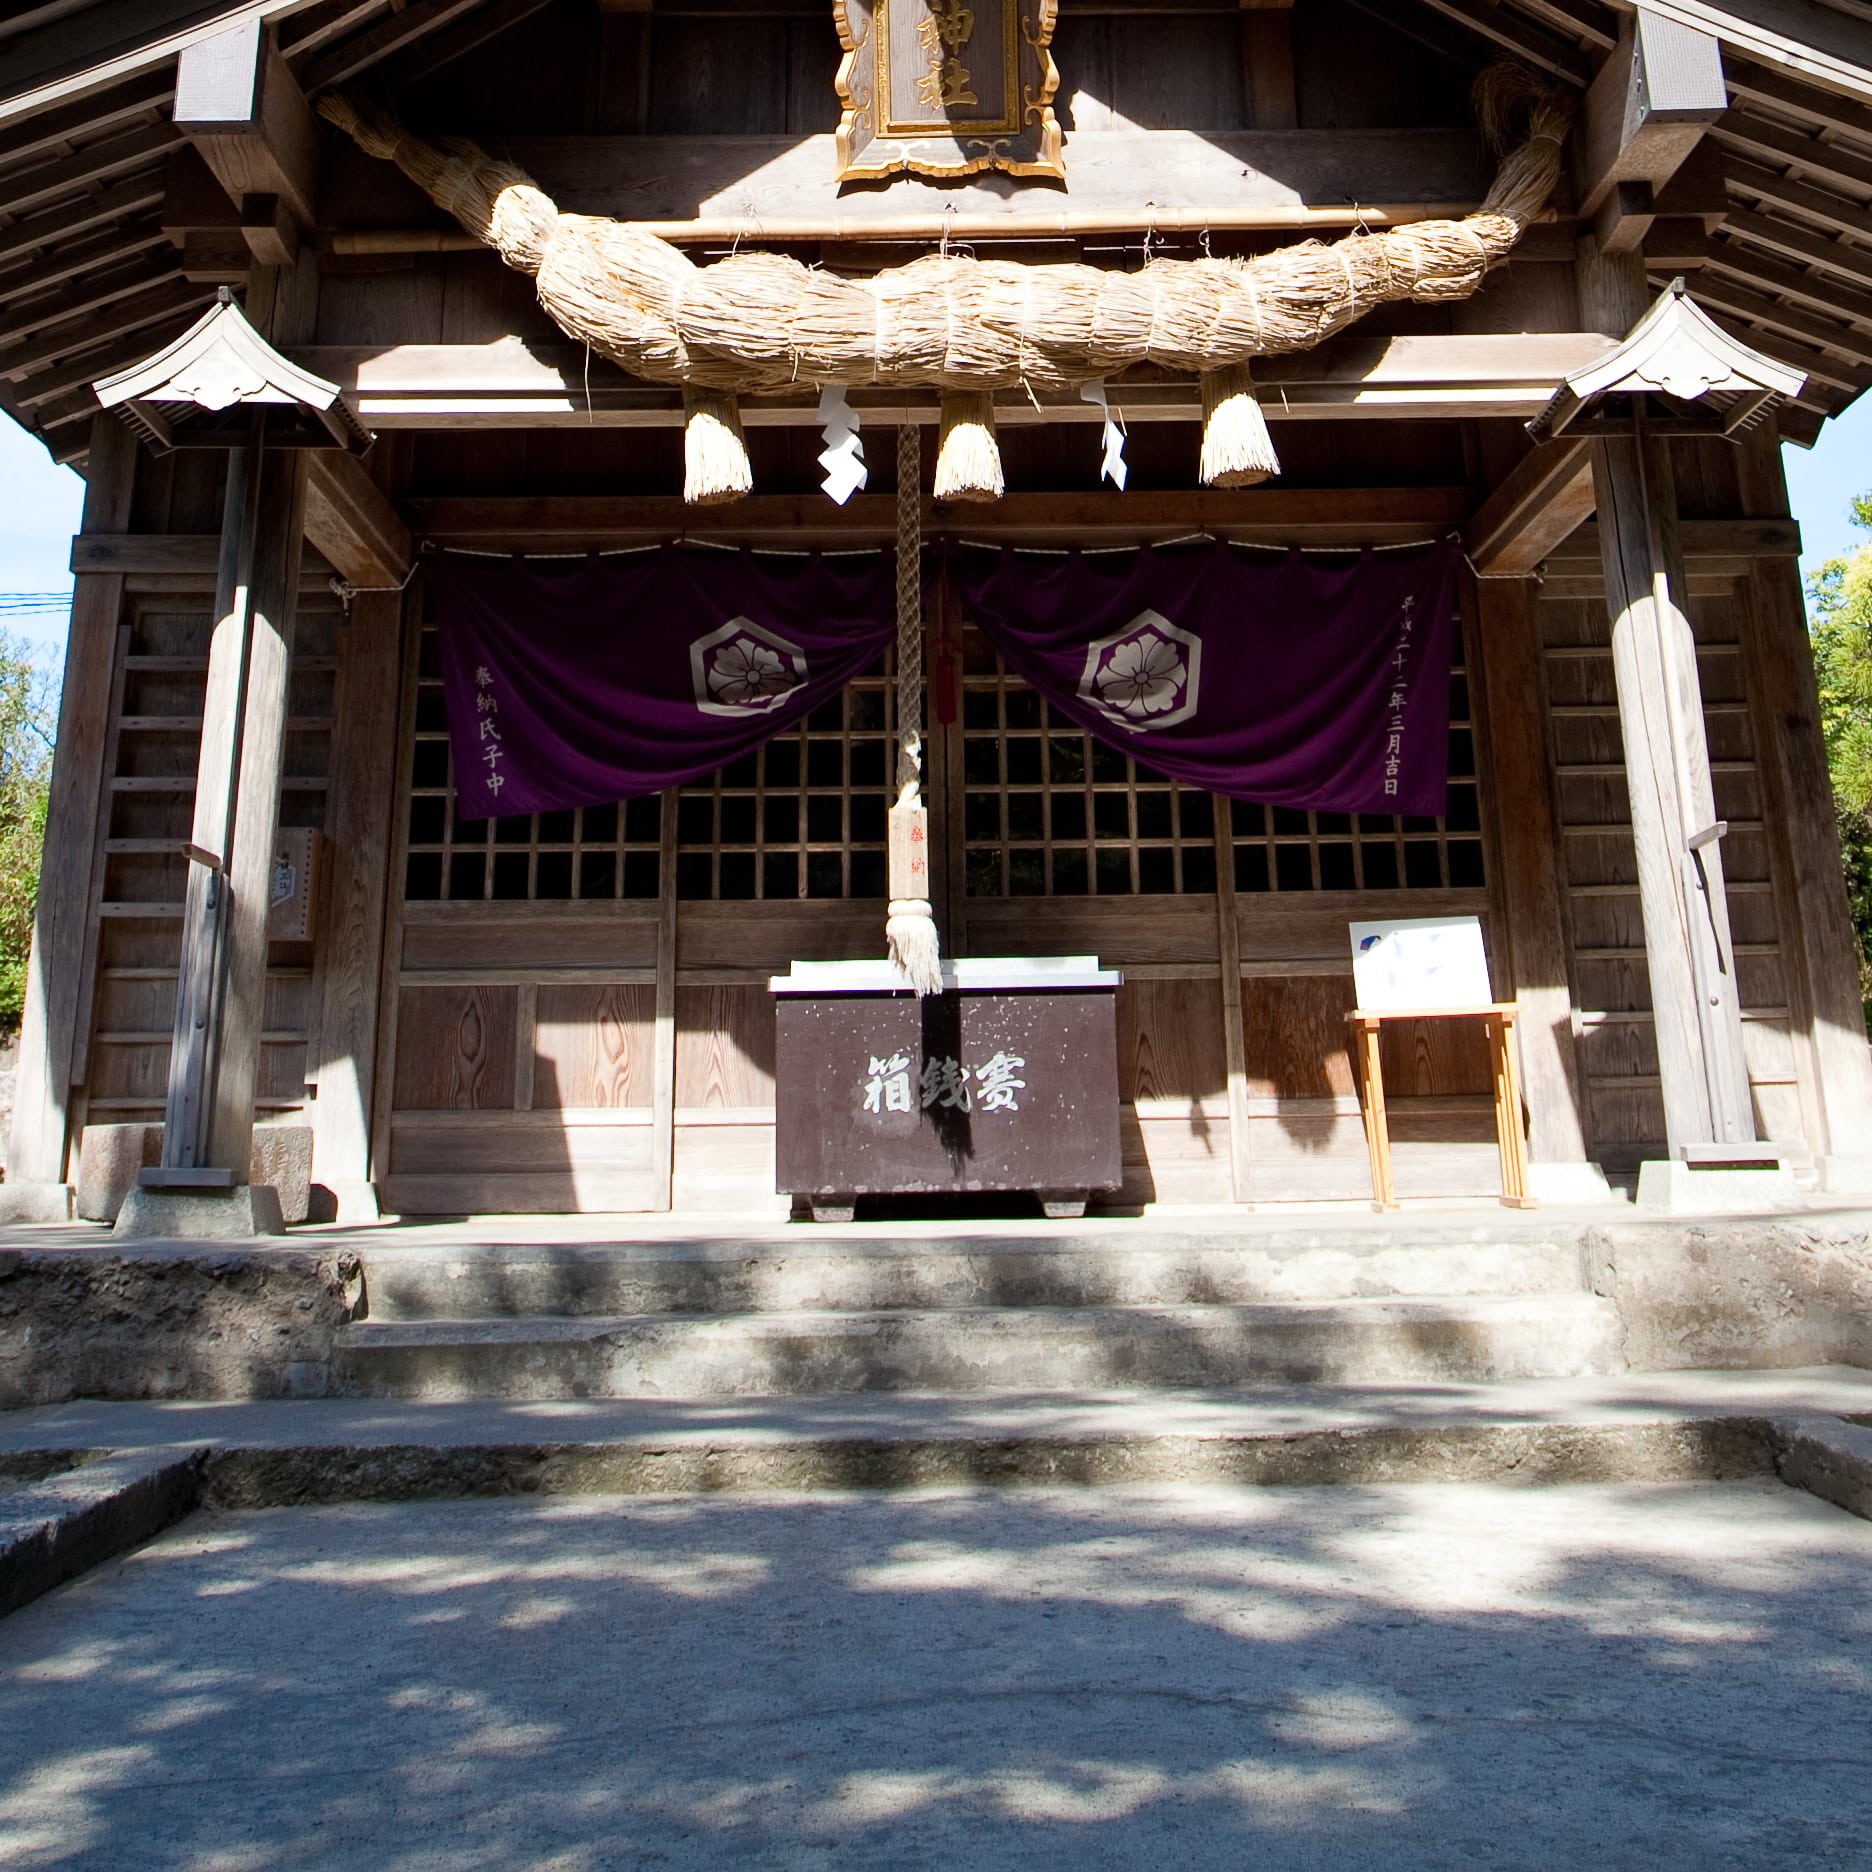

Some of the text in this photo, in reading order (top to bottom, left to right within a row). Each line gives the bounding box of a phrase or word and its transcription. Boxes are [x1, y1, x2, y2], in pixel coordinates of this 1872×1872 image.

[474, 665, 505, 797] 奉納氏子中
[911, 824, 925, 876] 奉納
